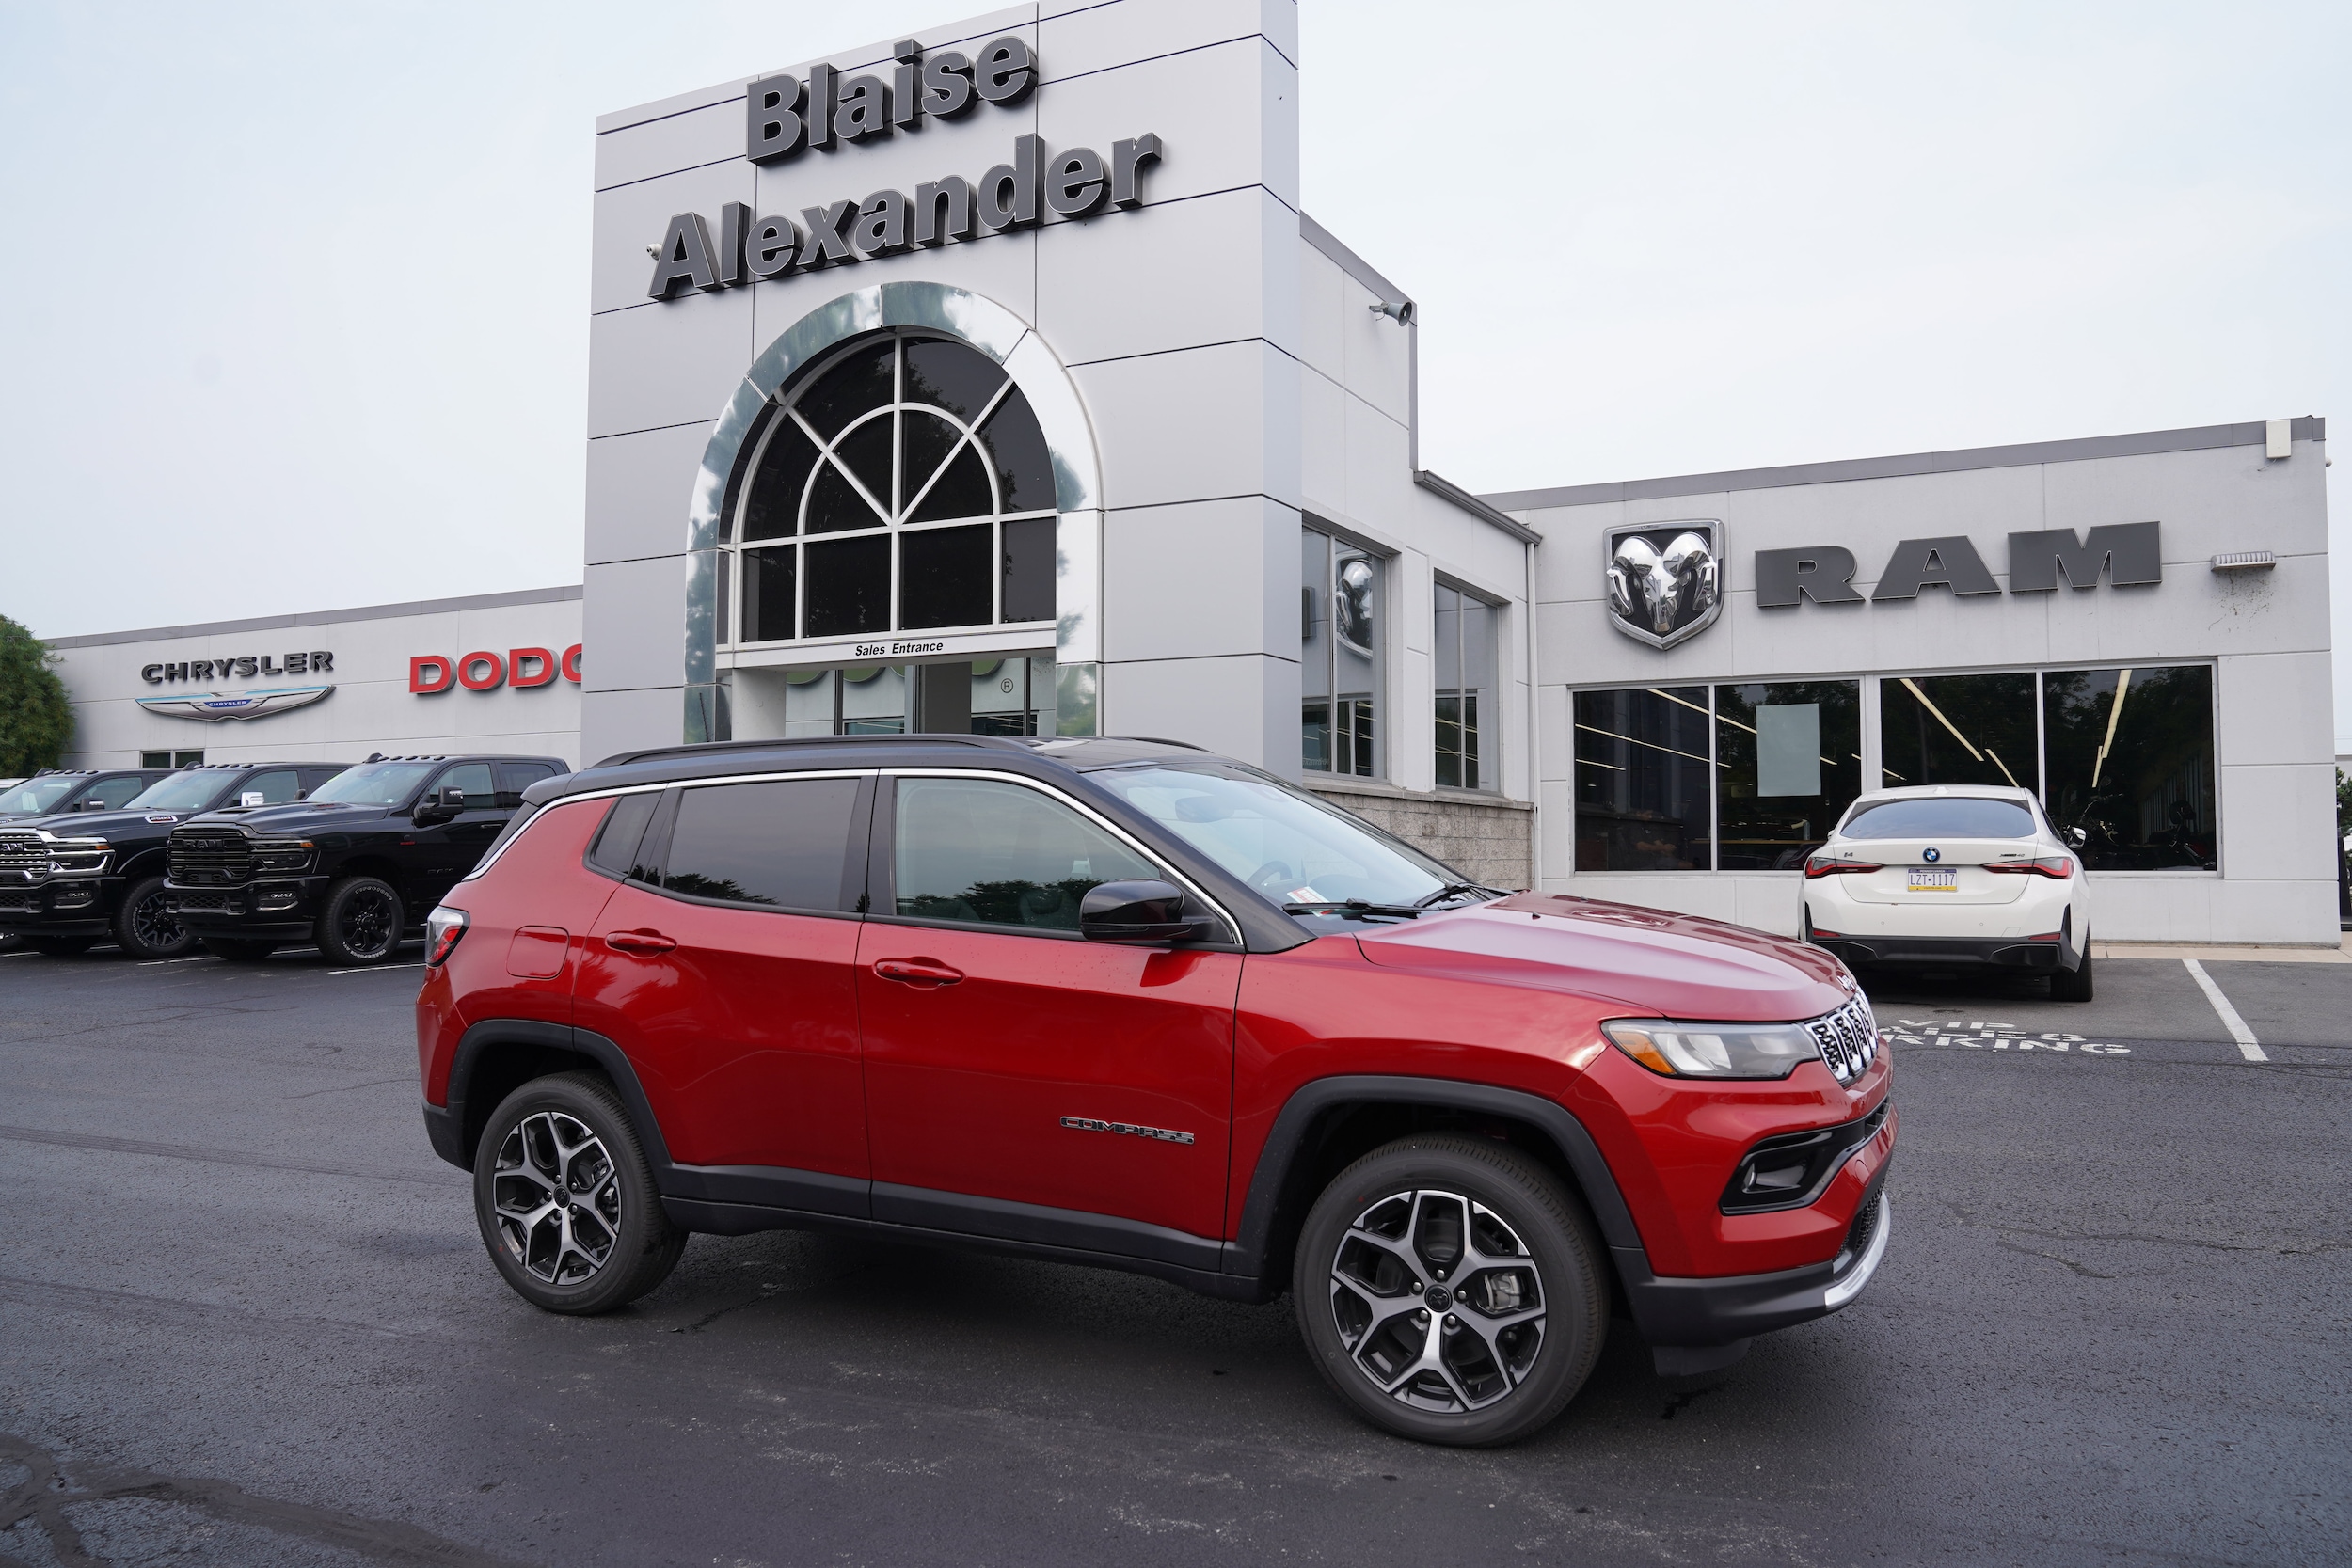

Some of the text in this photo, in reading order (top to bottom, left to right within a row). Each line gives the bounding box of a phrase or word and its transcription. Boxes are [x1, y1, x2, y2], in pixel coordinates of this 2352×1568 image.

[746, 36, 1038, 164] Blaise
[648, 133, 1161, 300] Alexander
[1755, 521, 2162, 607] RAM
[855, 641, 944, 657] Sales Entrance
[141, 651, 334, 683] CHRYSLER
[409, 643, 582, 694] DOD
[0, 842, 24, 852] AM
[1878, 1025, 2087, 1042] ALES
[1899, 1019, 2015, 1029] VIP
[1882, 1034, 2131, 1053] RKING
[1060, 1116, 1194, 1145] COMPASS
